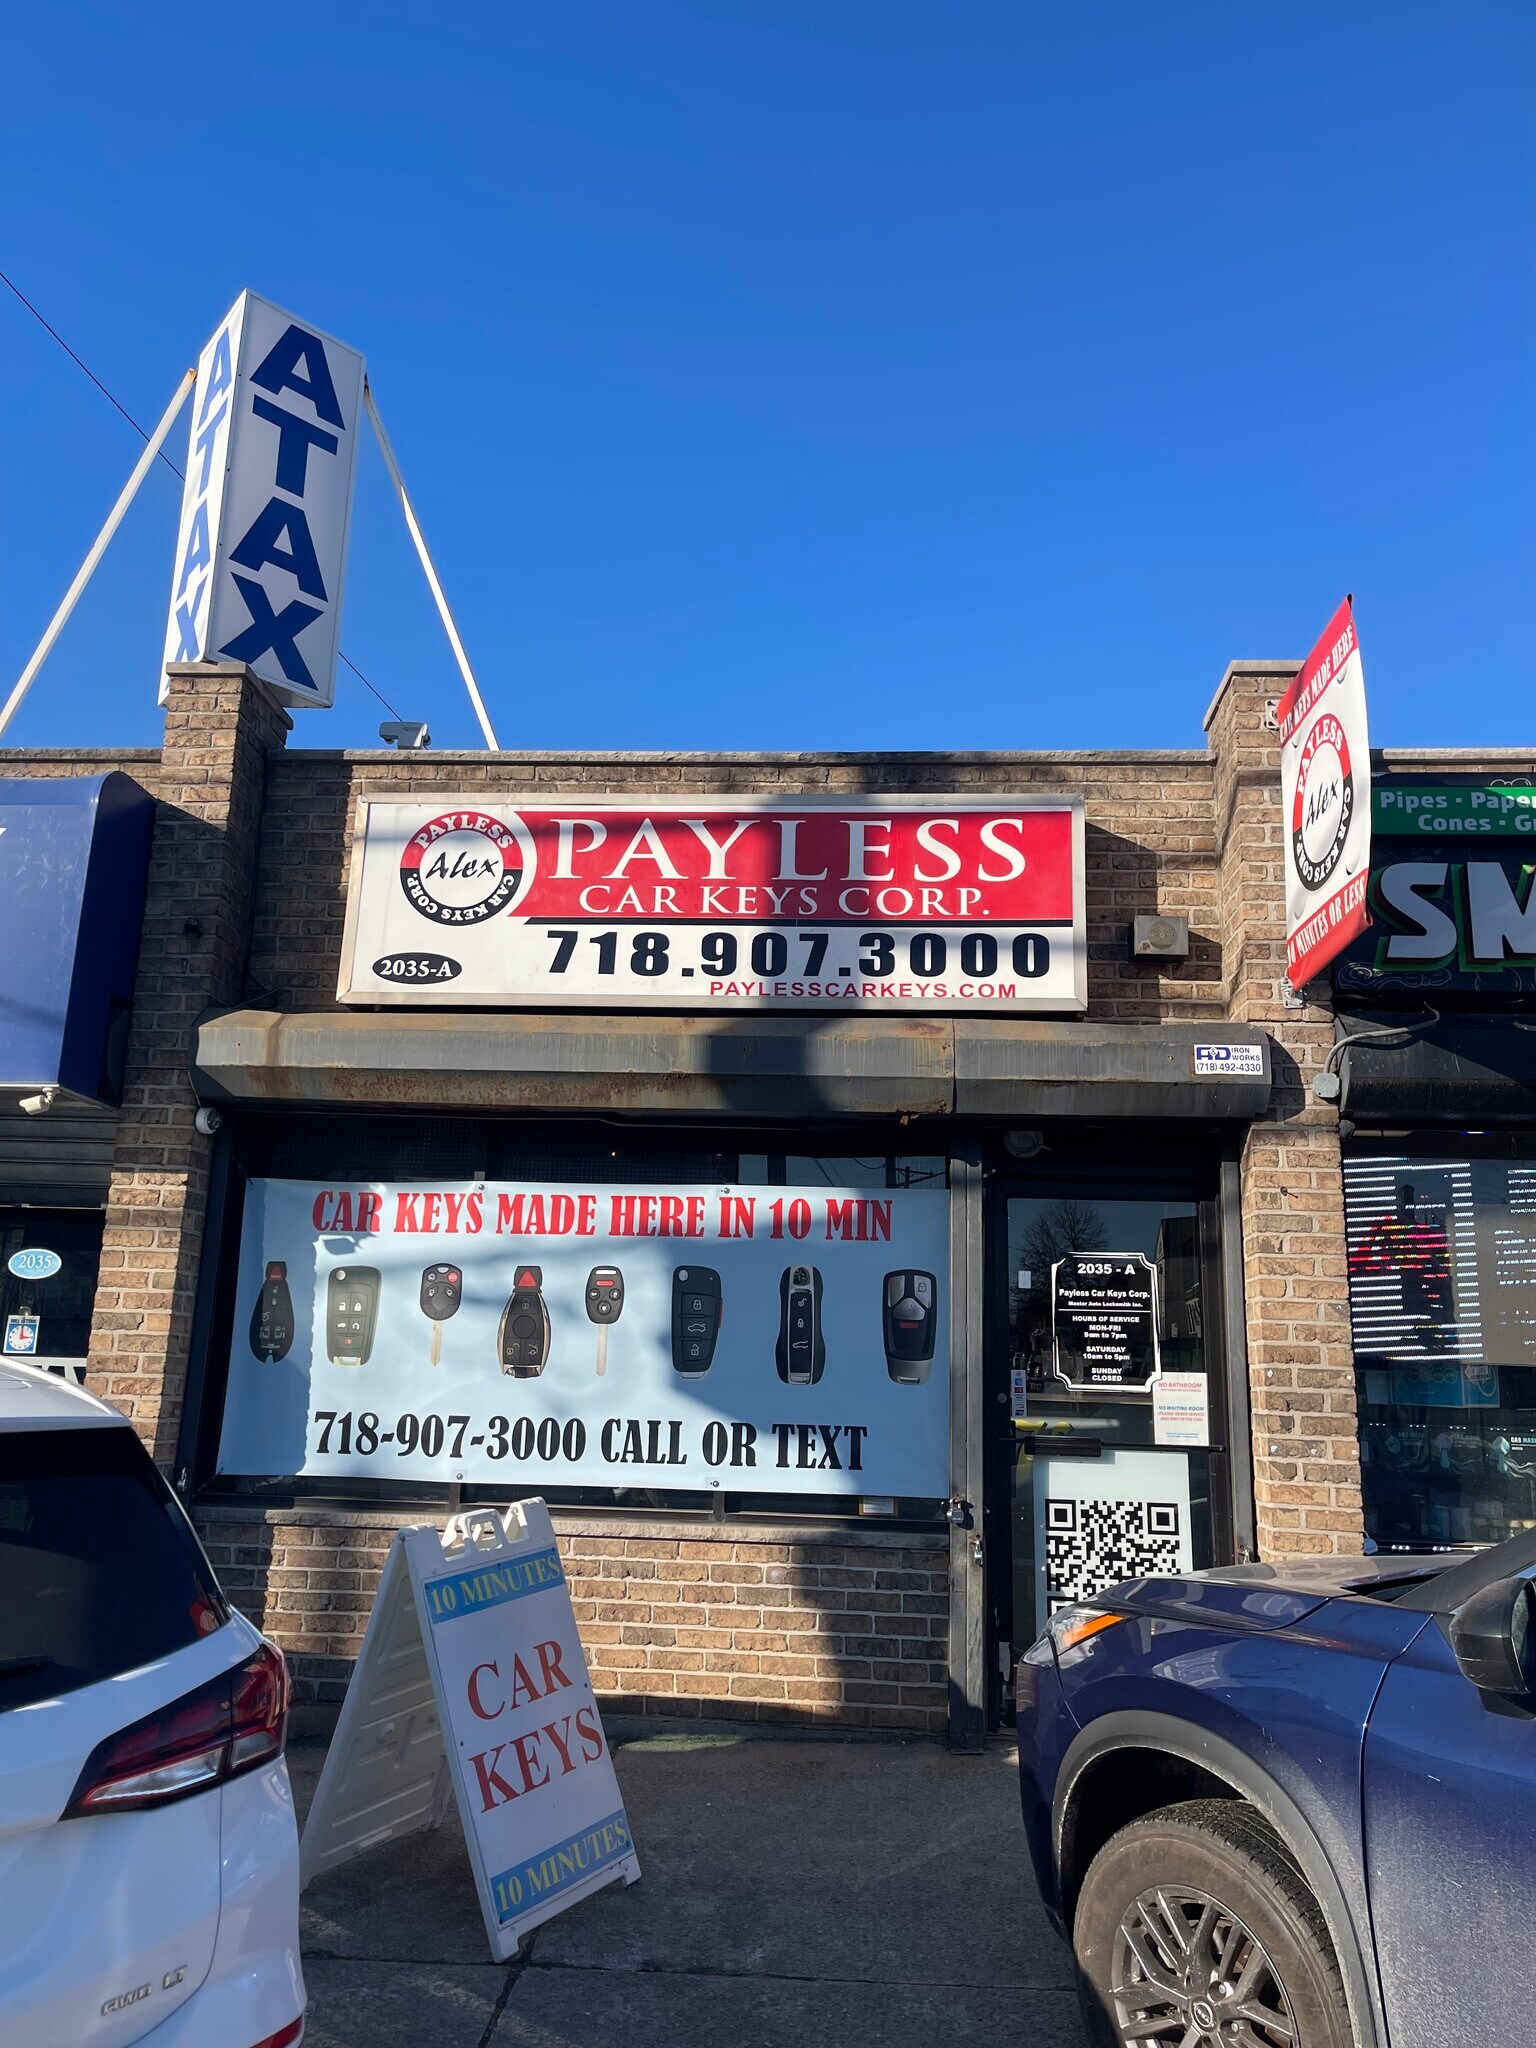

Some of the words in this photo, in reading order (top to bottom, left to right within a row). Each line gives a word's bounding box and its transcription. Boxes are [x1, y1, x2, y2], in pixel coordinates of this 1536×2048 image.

[175, 327, 232, 662] ATAX
[217, 324, 346, 691] ATAX
[1293, 686, 1311, 726] KEYS
[1311, 656, 1332, 701] MADE
[1331, 624, 1354, 672] HERE
[1297, 718, 1343, 792] PAYLESS
[1305, 778, 1339, 832] Alex
[1337, 786, 1351, 840] CAR
[1380, 791, 1448, 813] Pipes
[413, 814, 514, 850] PAYLESS
[1418, 814, 1492, 832] Cones
[425, 851, 500, 880] Alex
[547, 817, 1027, 883] PAYLESS
[1296, 834, 1314, 881] CORP.
[1313, 842, 1340, 883] KEYS
[406, 872, 438, 914] CORP.
[488, 874, 515, 907] CAR
[578, 884, 685, 915] CAR
[699, 885, 819, 916] KEYS
[838, 886, 990, 917] CORP.
[440, 903, 489, 921] KEYS
[1295, 908, 1329, 958] MINUTES
[1328, 896, 1343, 927] OR
[1343, 875, 1365, 915] LESS
[379, 959, 454, 978] 2035-A
[546, 929, 1051, 979] 718.907.3000
[709, 980, 1017, 999] PAYLESSCARKEYS.COM
[1196, 1063, 1218, 1072] (718)
[1219, 1063, 1261, 1072] 492-4330
[312, 1190, 384, 1233] CAR
[393, 1191, 484, 1234] KEYS
[495, 1193, 597, 1236] MADE
[608, 1195, 705, 1238] HERE
[717, 1196, 757, 1239] IN
[768, 1197, 812, 1240] 10
[824, 1198, 893, 1241] MIN
[17, 1254, 53, 1269] 2035
[1077, 1263, 1113, 1275] 2035
[1124, 1264, 1136, 1275] A
[1058, 1288, 1090, 1298] Payless
[1091, 1289, 1106, 1297] Car
[1106, 1289, 1127, 1299] Keys
[1128, 1289, 1150, 1299] Corp.
[1089, 1324, 1122, 1332] MON-FRI
[1086, 1345, 1126, 1353] SATURDAY
[314, 1410, 587, 1463] 718-907-3000
[600, 1418, 688, 1465] CALL
[702, 1421, 758, 1467] OR
[771, 1423, 868, 1471] TEXT
[430, 1584, 457, 1615] 10
[459, 1555, 561, 1607] MINUTES
[467, 1640, 573, 1721] CAR
[468, 1705, 603, 1813] KEYS
[495, 1874, 523, 1912] 10
[525, 1817, 627, 1896] MINUTES
[162, 1963, 188, 1990] LT
